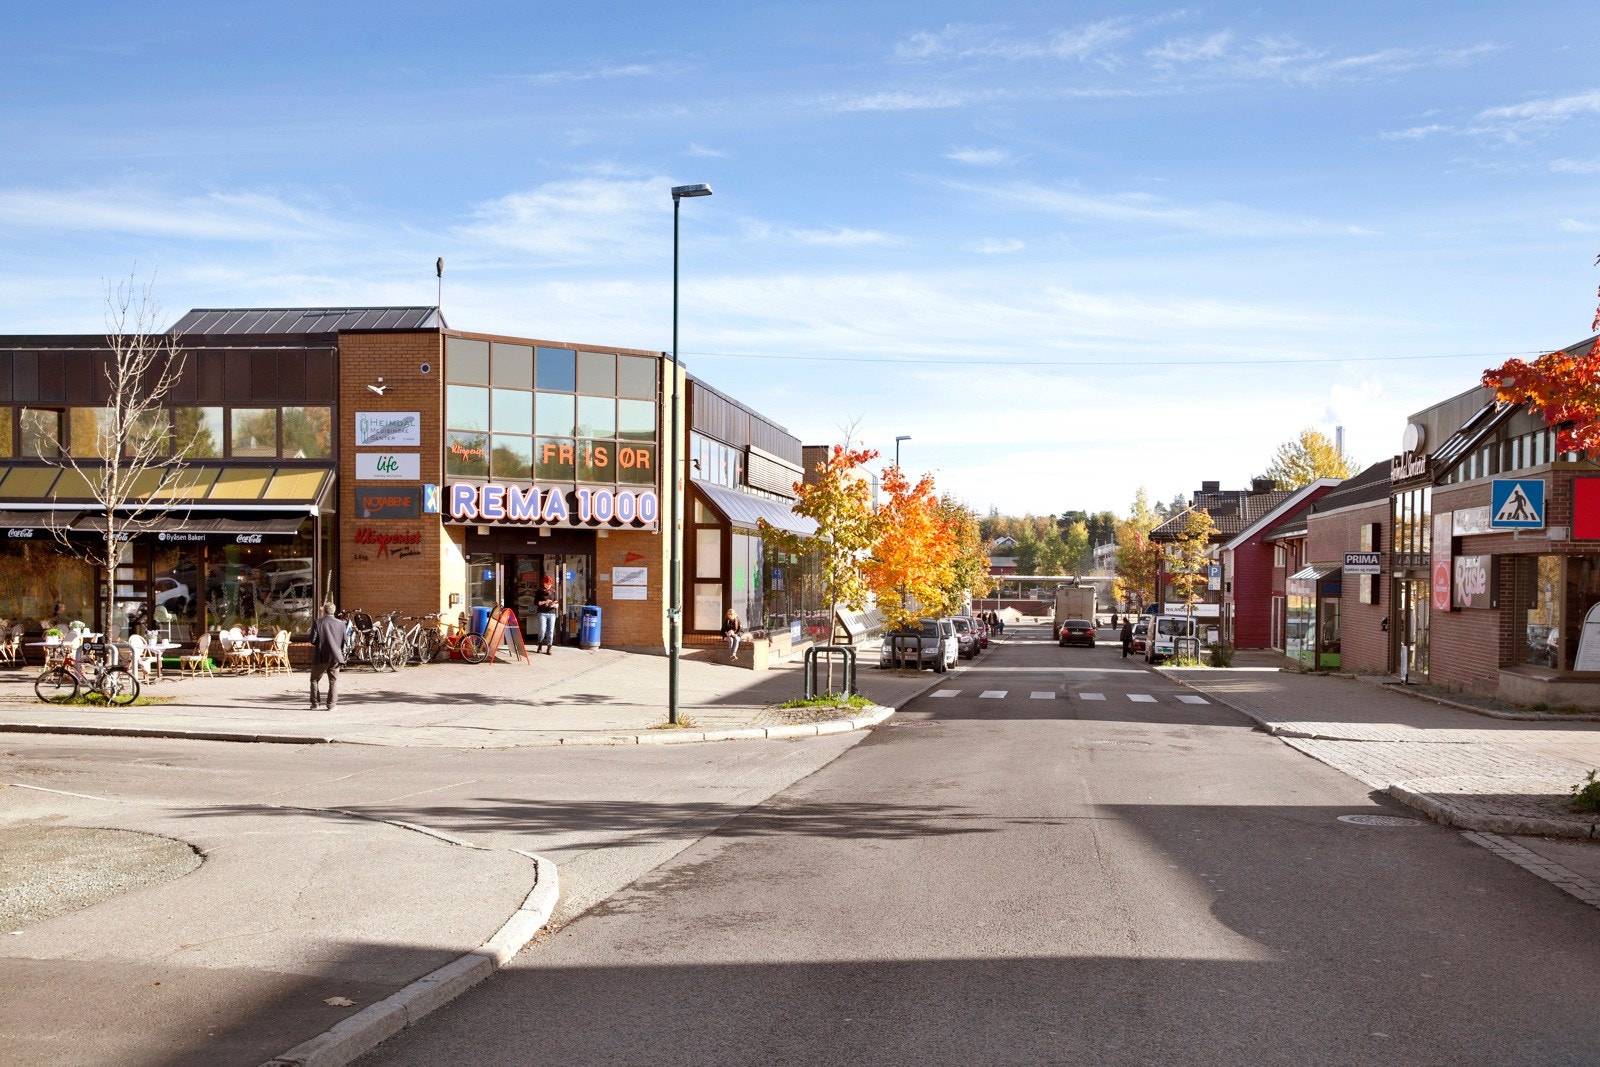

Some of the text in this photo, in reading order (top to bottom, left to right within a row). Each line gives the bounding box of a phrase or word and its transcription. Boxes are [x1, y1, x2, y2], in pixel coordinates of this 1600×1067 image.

[370, 418, 416, 427] HEIMDAL
[362, 496, 411, 510] NOTABENE
[450, 482, 658, 524] REMA 1000
[166, 533, 206, 542] Byåsen Bakeri
[1346, 555, 1378, 564] PRIMA
[1211, 567, 1218, 576] P
